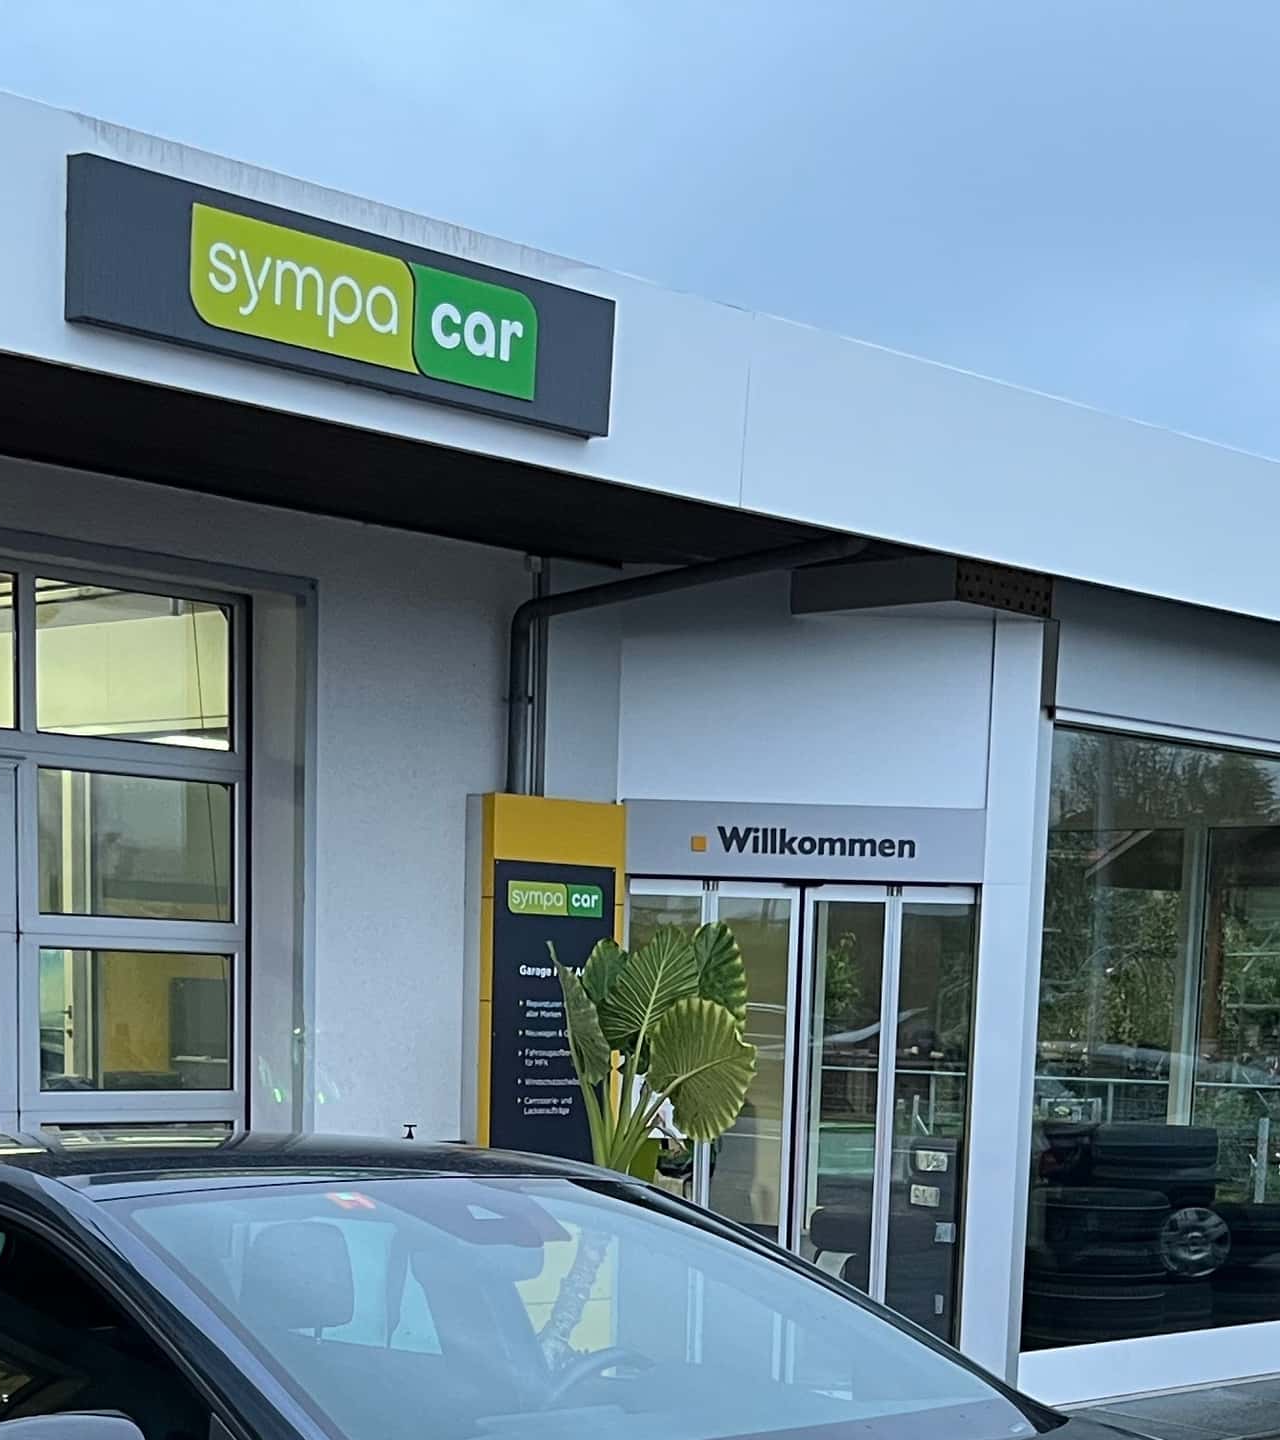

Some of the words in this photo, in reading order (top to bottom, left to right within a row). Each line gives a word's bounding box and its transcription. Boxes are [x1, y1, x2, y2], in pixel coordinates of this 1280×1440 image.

[207, 241, 399, 338] sympa
[431, 302, 523, 363] car
[717, 826, 916, 860] Willkommen
[511, 889, 564, 910] sympa
[571, 891, 598, 909] car
[519, 964, 552, 978] Garage
